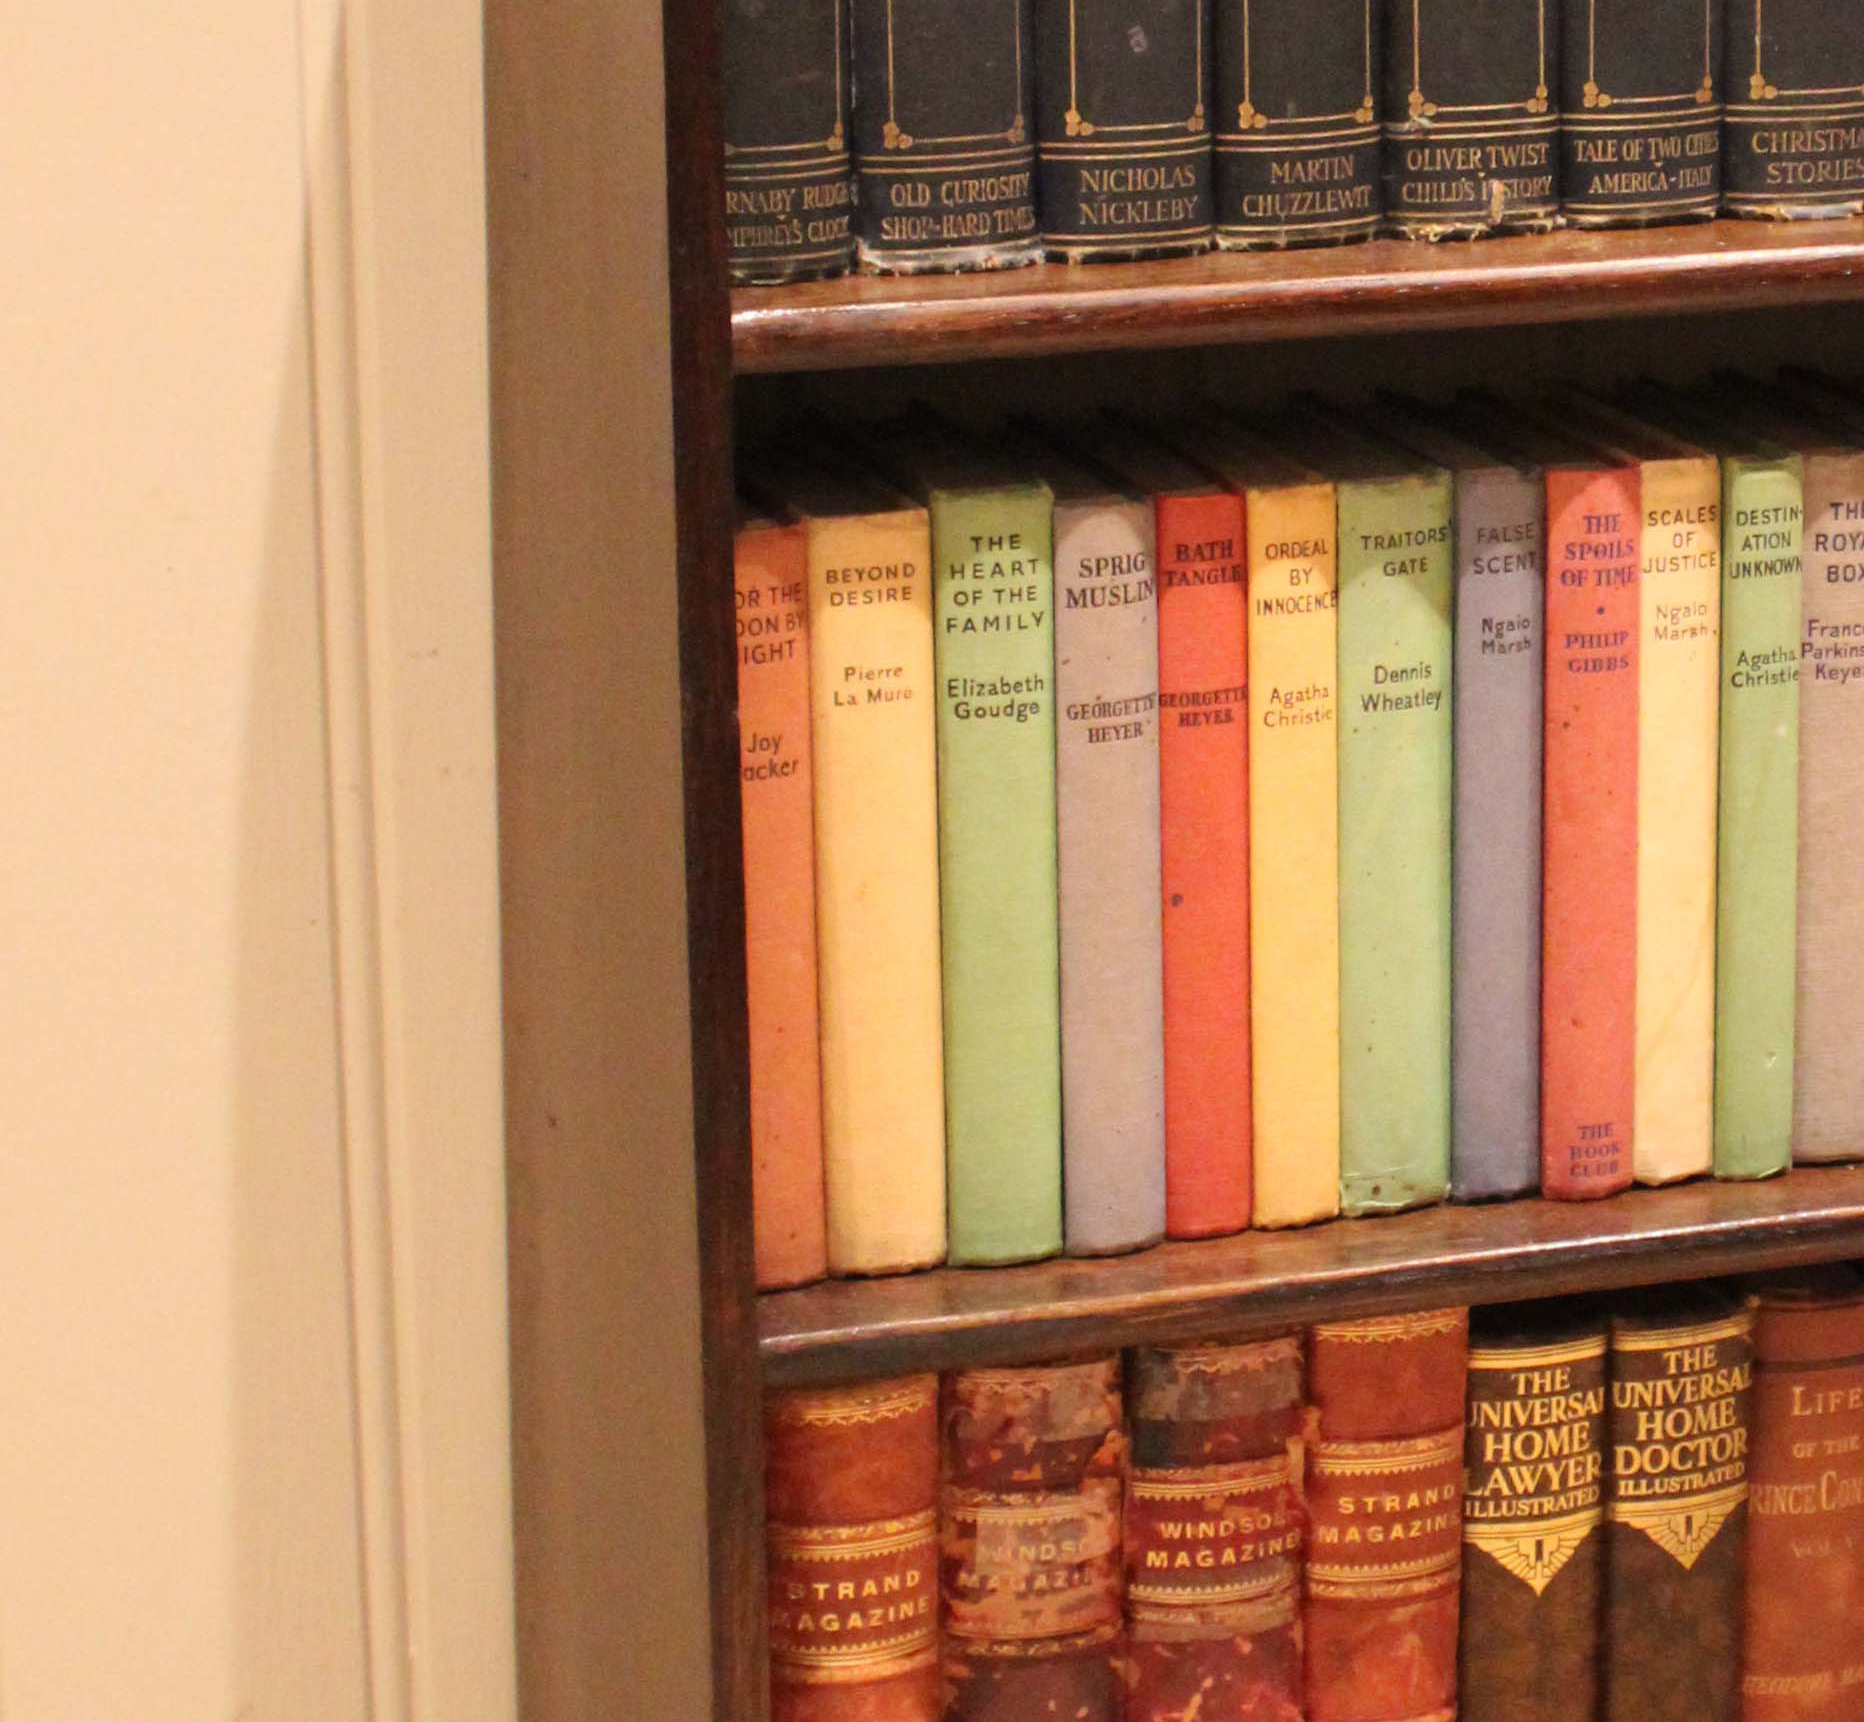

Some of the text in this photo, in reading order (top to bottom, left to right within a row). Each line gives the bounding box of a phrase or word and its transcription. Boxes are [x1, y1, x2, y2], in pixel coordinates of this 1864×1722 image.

[1405, 141, 1551, 173] OLIVER TWIST
[1573, 129, 1720, 164] TALE OF TWO CITIES
[1079, 164, 1197, 193] NICHOLAS
[1269, 153, 1354, 184] MARTIN
[890, 172, 1031, 209] OLD CURIOSITY
[1241, 184, 1373, 219] CHUZZLEWIT
[1079, 195, 1200, 225] NICKLEBY
[1582, 514, 1621, 534] THE
[1647, 504, 1718, 527] SCALES
[970, 533, 1023, 551] THE
[1476, 522, 1536, 544] FALSE
[1671, 532, 1697, 549] OF
[1741, 530, 1793, 553] ATION
[1173, 539, 1235, 563] BATH
[1264, 538, 1329, 561] ORDEAL
[1564, 538, 1636, 561] SPOILS
[825, 561, 917, 585] BEYOND
[951, 558, 1040, 581] HEART
[1078, 551, 1146, 580] SPRIG
[1382, 557, 1429, 578] GATE
[1472, 551, 1537, 575] SCENT
[1643, 550, 1718, 574] JUSTICE
[1165, 564, 1242, 588] TANGLE
[1288, 568, 1313, 588] BY
[1559, 563, 1637, 587] OF TIME
[829, 585, 914, 607] DESIRE
[953, 584, 1039, 608] OF THE
[1065, 578, 1154, 610] MUSLIN
[1256, 591, 1337, 616] INNOCENCE
[946, 610, 1046, 635] FAMILY
[1655, 601, 1708, 625] Ngaio
[1481, 617, 1531, 641] Ngaio
[1563, 630, 1630, 651] PHILIP
[1480, 638, 1532, 657] Marsh
[1735, 645, 1797, 671] Agatha
[844, 665, 904, 682] Pierre
[1373, 661, 1433, 686] Dennis
[1567, 654, 1630, 675] GIBBS
[833, 685, 914, 707] La Mure
[947, 673, 1046, 699] Elizabeth
[1269, 682, 1330, 710] Agatha
[954, 701, 1042, 724] Goudge
[1066, 690, 1157, 721] GEORGETTE
[1360, 689, 1443, 714] Wheatley
[1178, 707, 1236, 728] HEYER
[1263, 708, 1334, 728] Christie
[745, 731, 785, 755] Joy
[1087, 721, 1145, 745] HEYER
[1663, 1344, 1719, 1375] THE
[1511, 1366, 1572, 1397] THE
[1612, 1361, 1752, 1409] UNIVERSAL
[1635, 1396, 1738, 1442] HOME
[1484, 1421, 1591, 1464] HOME
[1614, 1427, 1748, 1476] DOCTOR
[1617, 1461, 1746, 1497] ILLUSTRATED
[1337, 1484, 1457, 1516] STRAND
